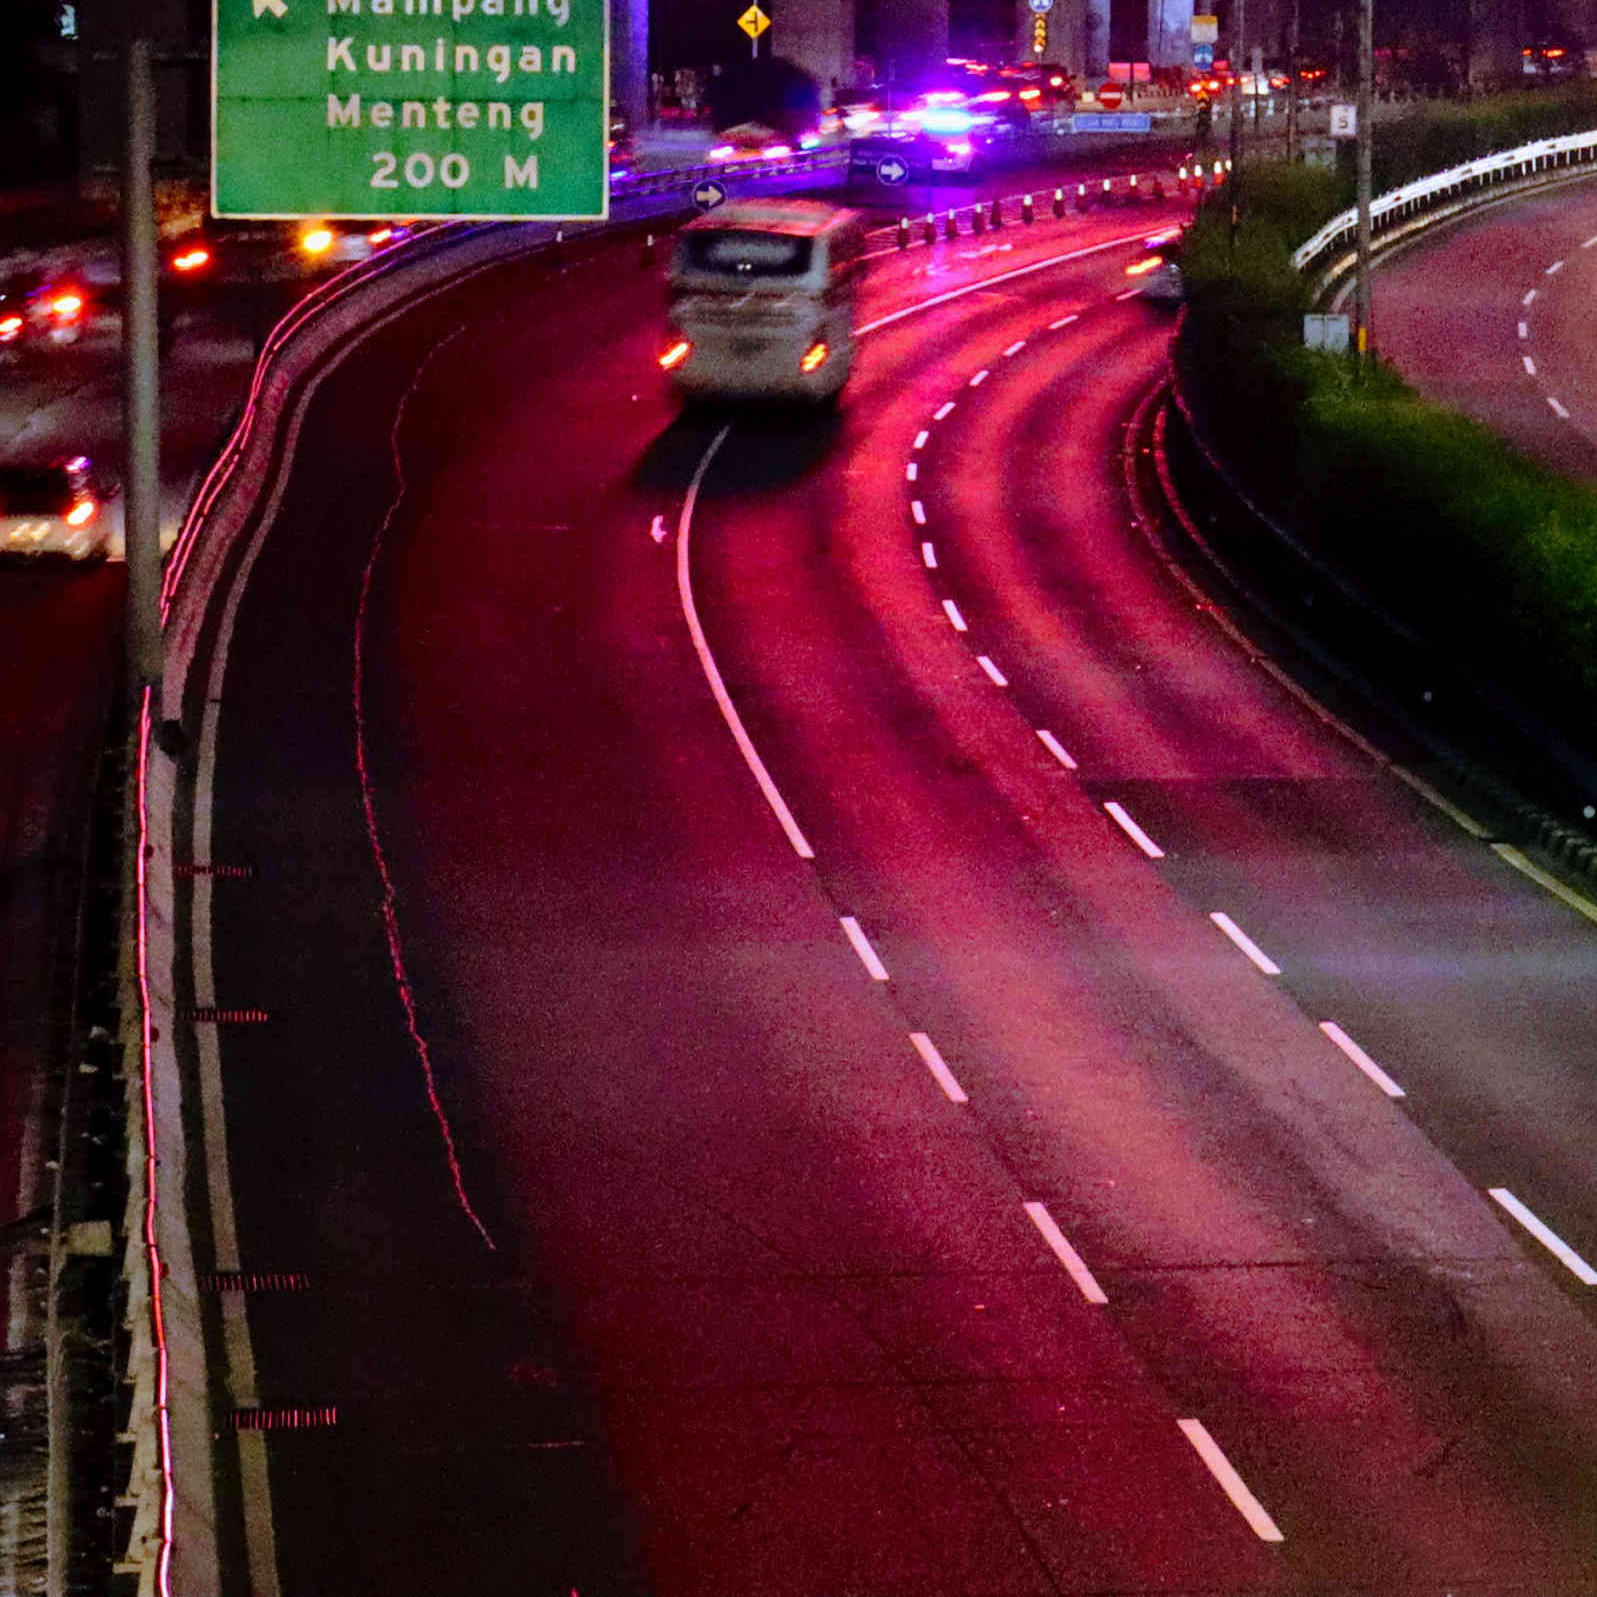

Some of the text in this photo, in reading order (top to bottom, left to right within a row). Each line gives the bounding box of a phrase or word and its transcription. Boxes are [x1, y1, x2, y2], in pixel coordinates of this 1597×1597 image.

[326, 37, 577, 82] Kuningan
[326, 94, 545, 139] Menteng
[370, 152, 540, 190] 200 M
